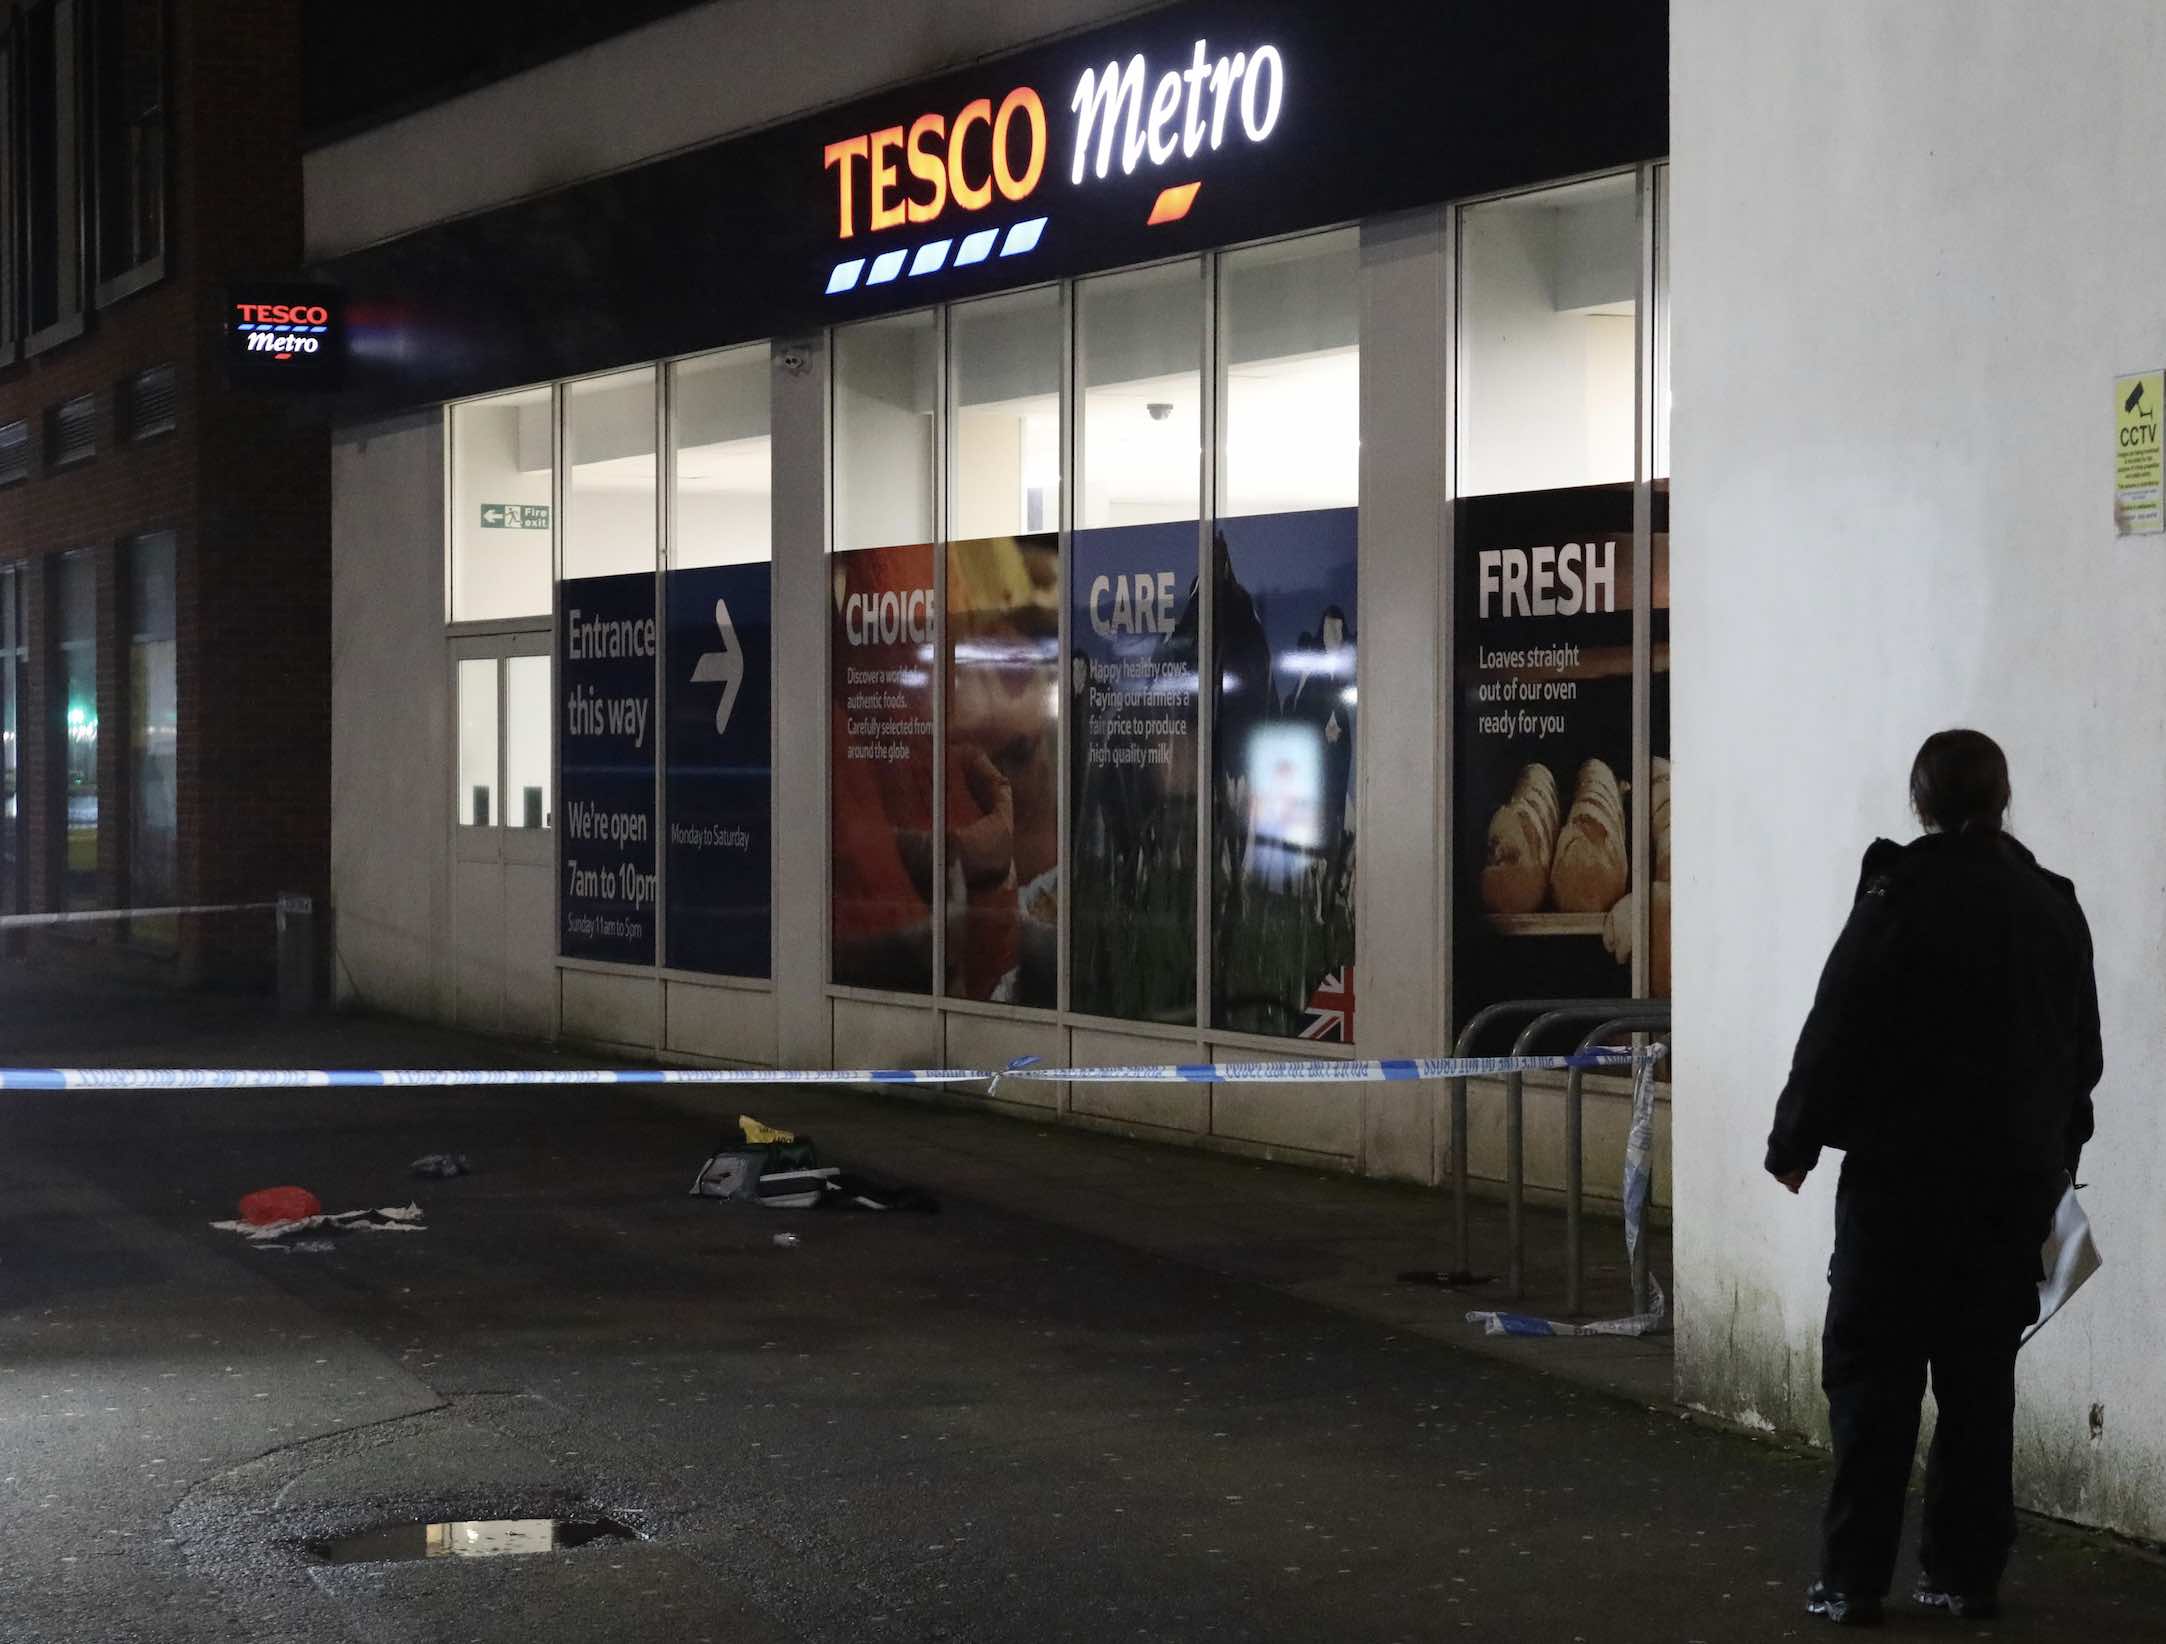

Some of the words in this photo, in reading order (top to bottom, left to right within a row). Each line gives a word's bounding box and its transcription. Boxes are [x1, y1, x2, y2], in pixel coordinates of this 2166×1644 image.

[825, 86, 1048, 239] TESCO
[1071, 38, 1284, 185] Metro
[237, 304, 328, 325] TESCO
[247, 332, 319, 353] Metro
[2119, 424, 2157, 447] CCTV
[524, 507, 548, 518] Fire
[524, 518, 547, 528] exit
[1478, 541, 1616, 619] FRESH
[1090, 572, 1176, 637] CARE
[569, 609, 656, 659] Entrance
[1089, 658, 1121, 683] Happy
[1122, 656, 1161, 681] healthy
[1480, 646, 1525, 669] Loaves
[1527, 642, 1580, 672] straight
[847, 667, 879, 684] Discover
[880, 671, 885, 683] a
[1479, 680, 1501, 701] out
[1503, 677, 1519, 701] of
[1519, 683, 1542, 700] our
[1543, 682, 1577, 700] oven
[847, 691, 882, 709] authentic
[1089, 687, 1123, 711] Paying
[1124, 691, 1142, 706] our
[1143, 689, 1182, 706] farmers
[1183, 691, 1190, 706] a
[568, 684, 604, 735] this
[608, 698, 648, 748] way
[847, 717, 880, 739] Carefully
[881, 717, 913, 735] selected
[914, 717, 934, 735] from
[1089, 714, 1106, 735] fair
[1107, 715, 1132, 740] price
[1133, 717, 1143, 735] to
[1145, 713, 1187, 739] produce
[1479, 709, 1516, 739] ready
[1517, 709, 1538, 733] for
[1539, 715, 1565, 739] you
[847, 741, 874, 759] around
[874, 741, 887, 759] the
[1089, 742, 1111, 768] high
[1112, 743, 1148, 768] quality
[568, 801, 609, 840] We're
[611, 813, 648, 850] open
[671, 823, 703, 849] Monday
[703, 826, 713, 846] to
[713, 824, 751, 851] Saturday
[568, 860, 598, 898] 7am
[600, 866, 616, 900] to
[618, 863, 657, 911] 10pm
[568, 912, 595, 939] Sunday
[616, 918, 625, 937] to
[625, 917, 643, 943] 5pm
